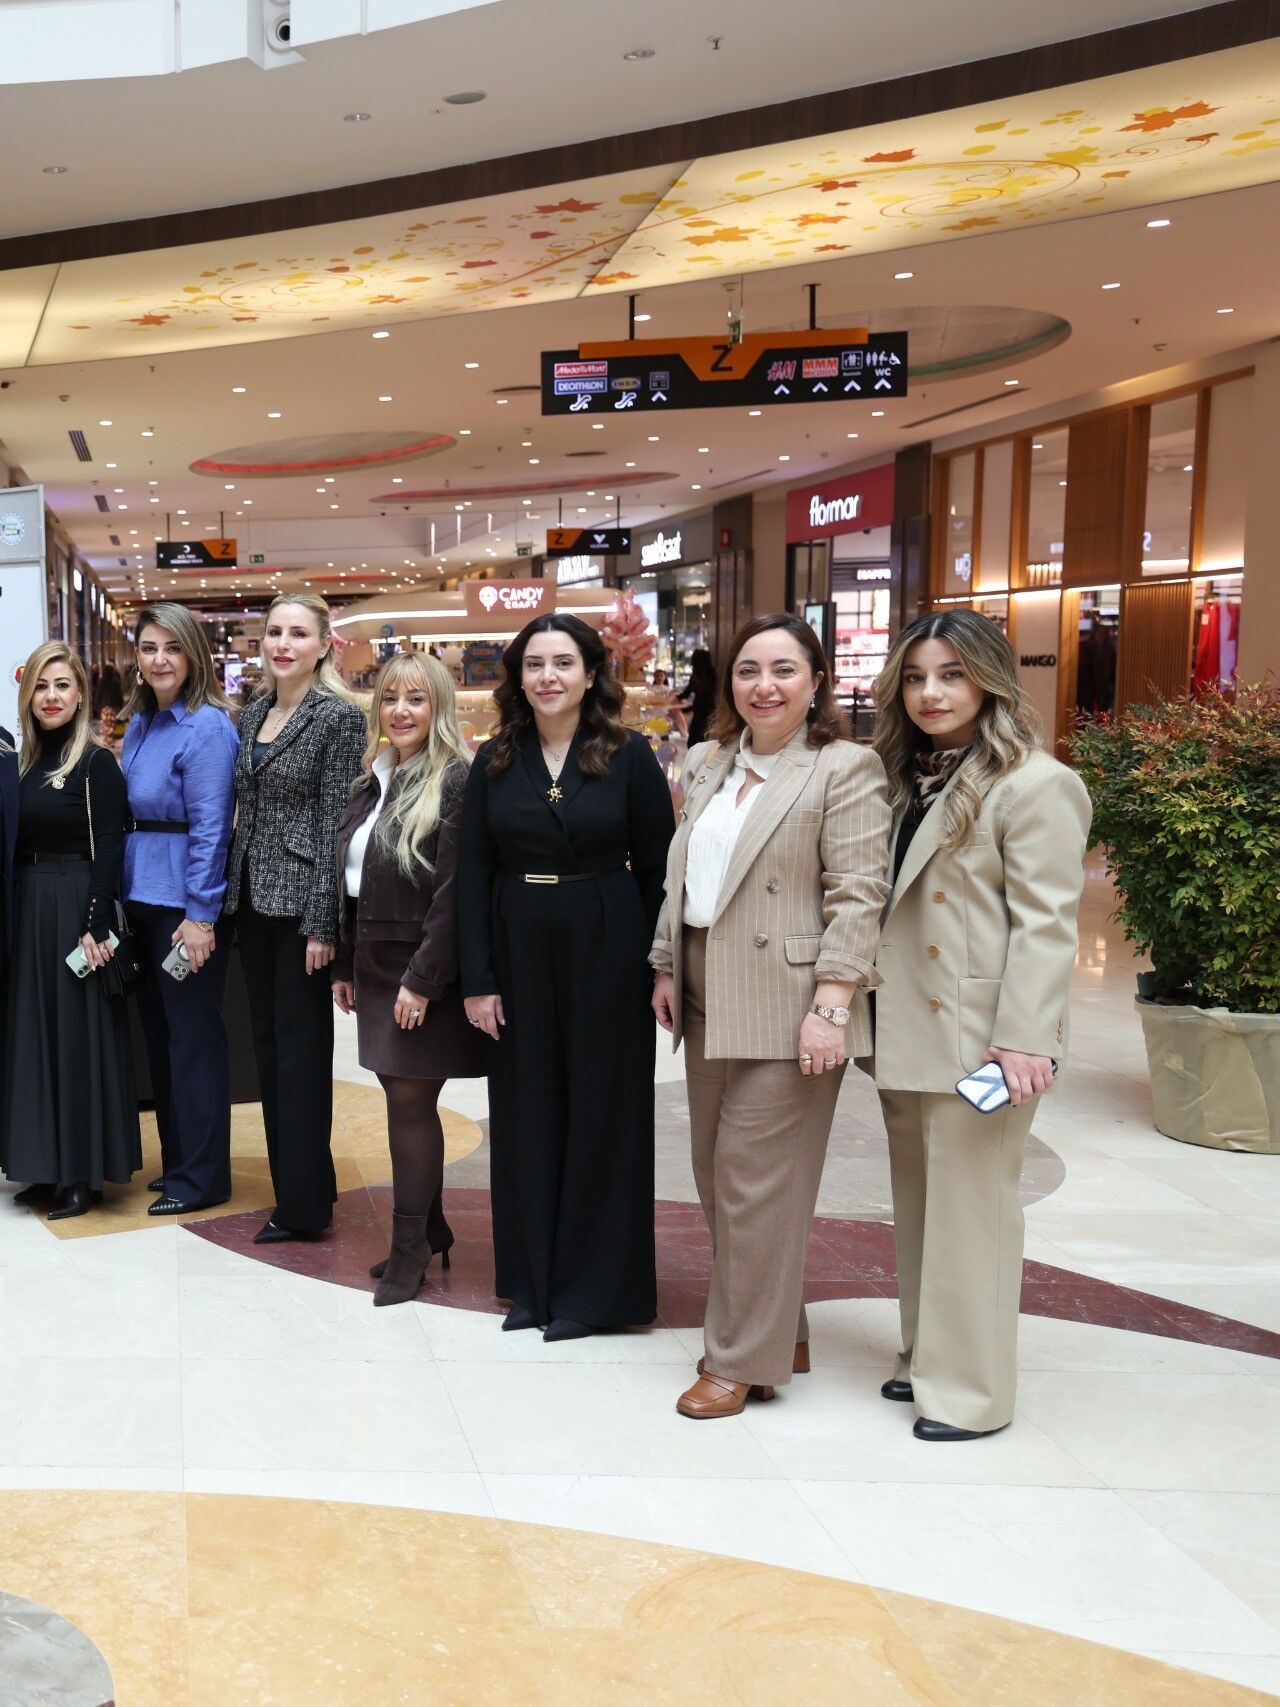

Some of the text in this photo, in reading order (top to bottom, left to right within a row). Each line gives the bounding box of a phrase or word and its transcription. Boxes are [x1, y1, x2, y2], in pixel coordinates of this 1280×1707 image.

[711, 344, 733, 372] Z
[875, 367, 891, 376] WC
[558, 381, 604, 391] DECATHLON
[809, 495, 859, 527] flormar
[554, 533, 564, 544] Z
[221, 543, 231, 555] Z
[499, 587, 544, 601] CANDY
